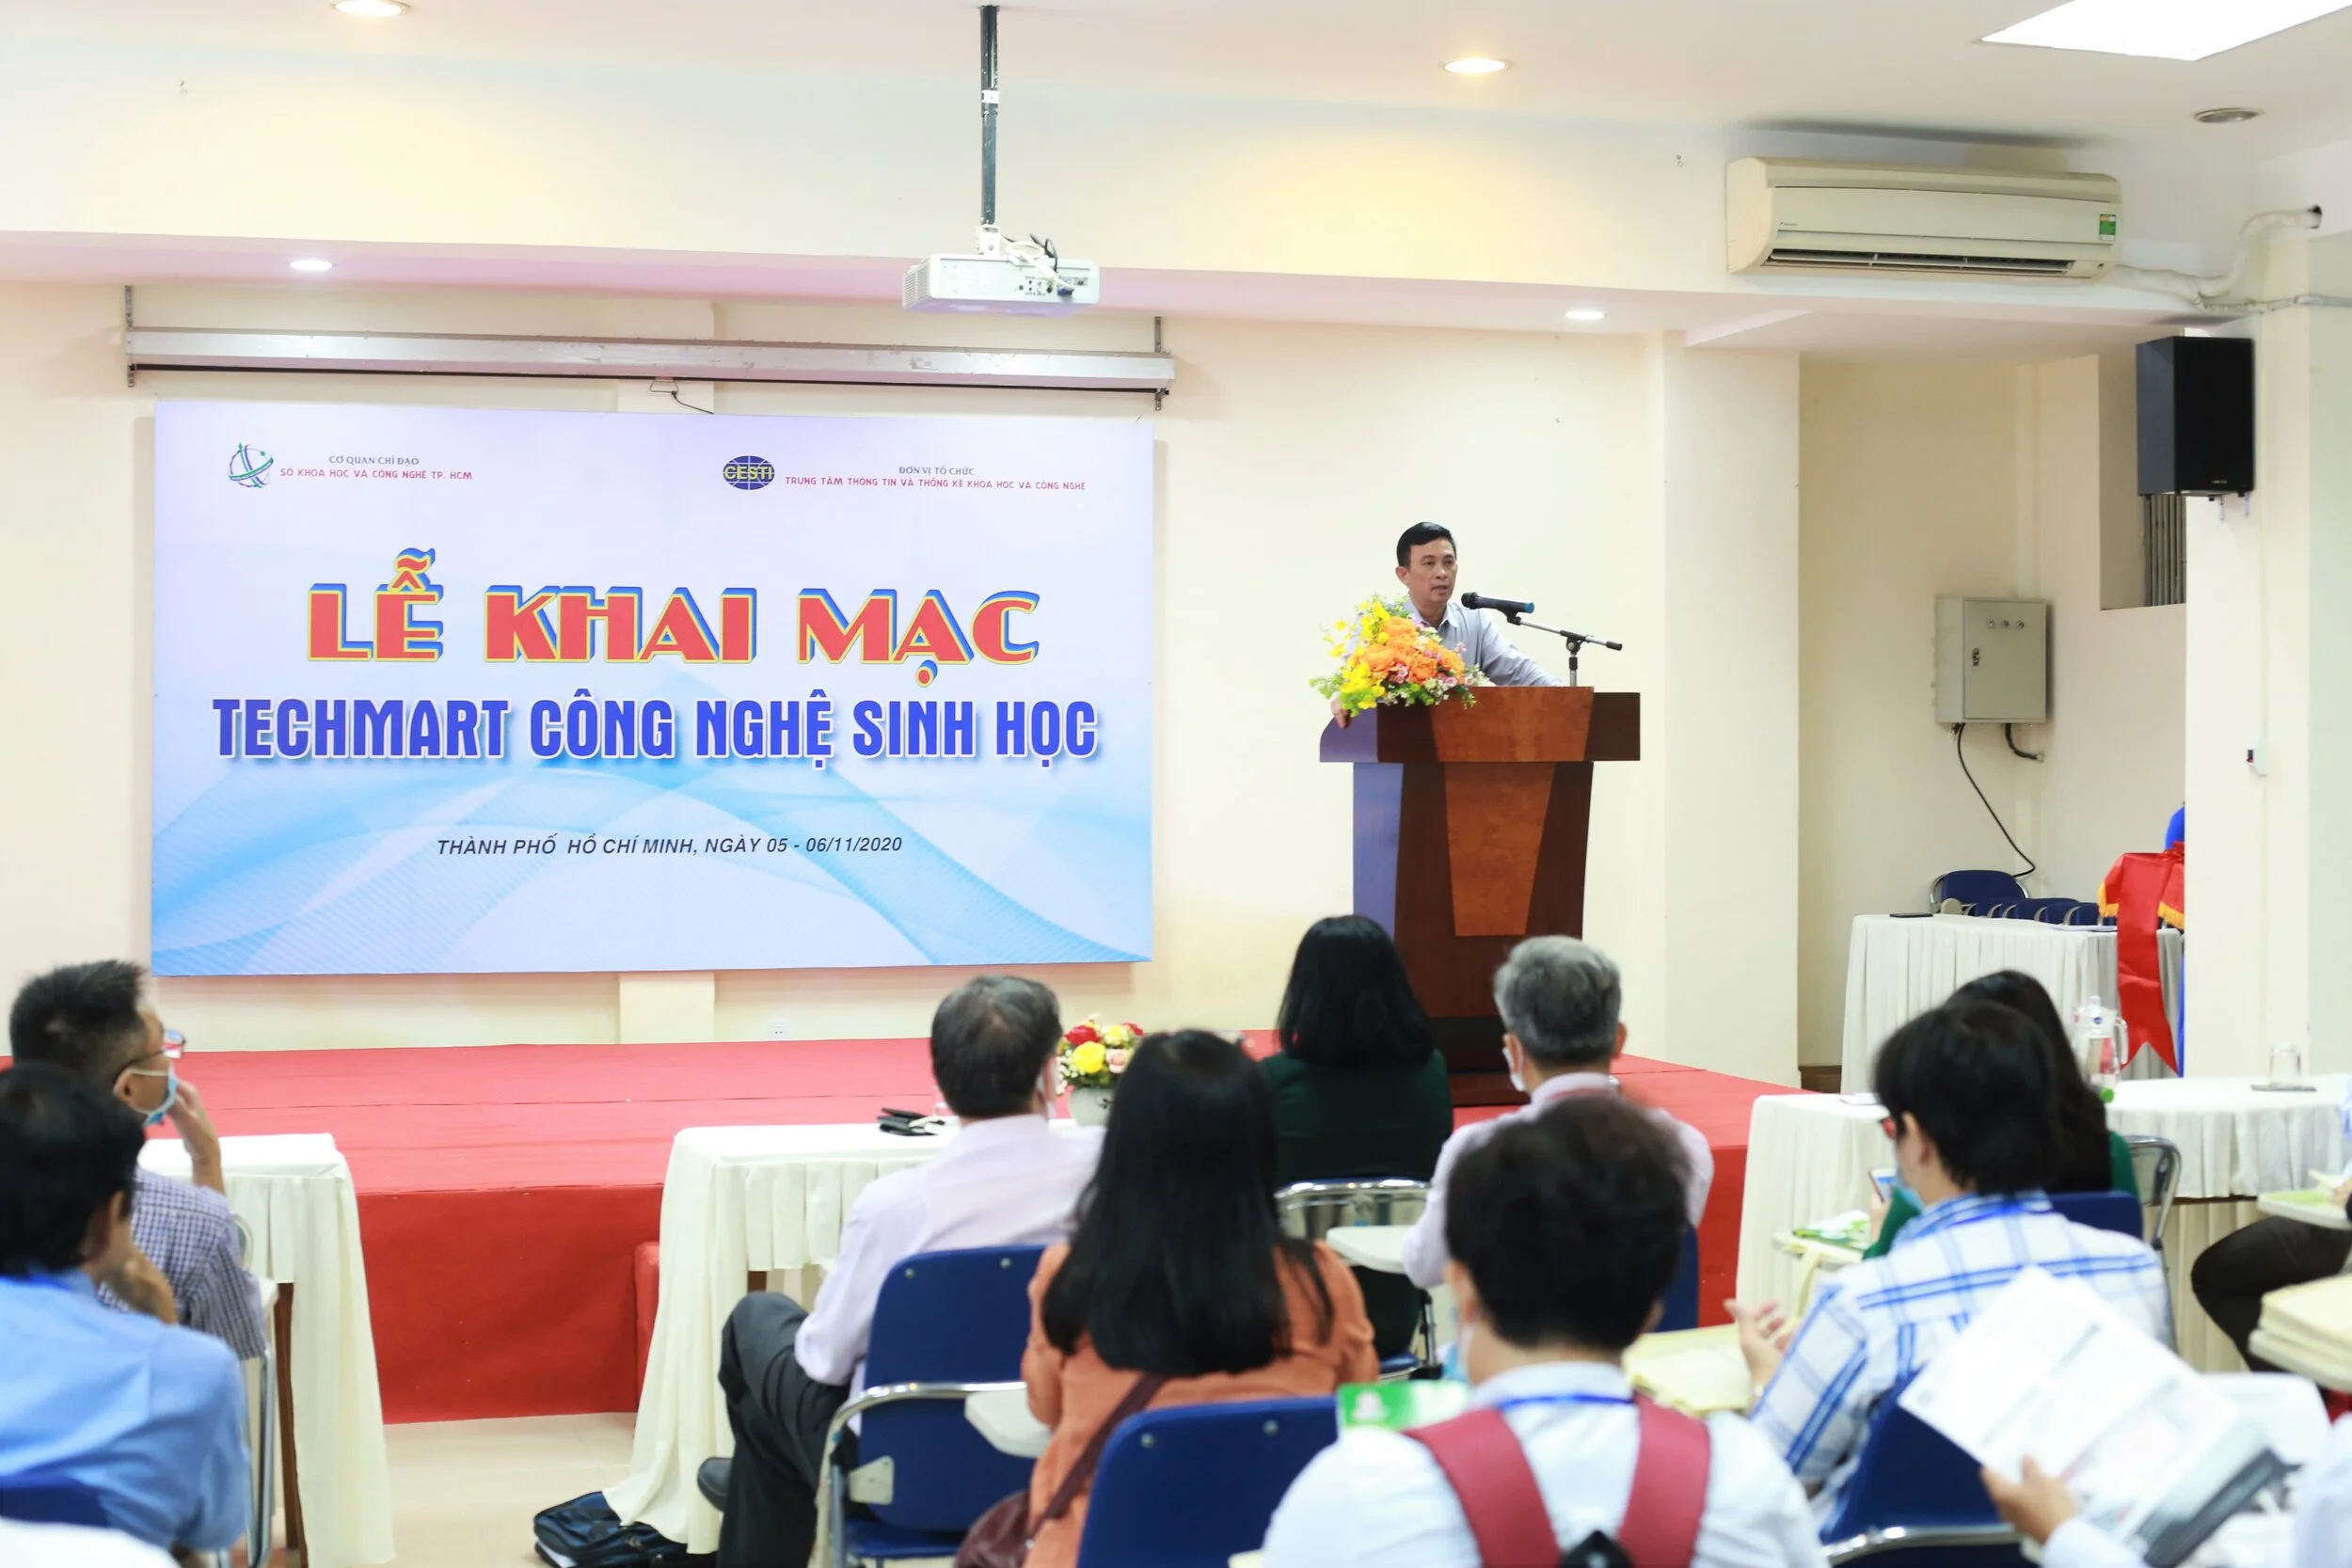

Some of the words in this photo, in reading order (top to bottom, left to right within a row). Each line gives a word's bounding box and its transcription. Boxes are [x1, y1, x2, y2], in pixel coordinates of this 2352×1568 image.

[328, 455, 344, 464] CƠ
[346, 456, 375, 465] QUAN
[297, 468, 326, 477] KHOA
[450, 471, 472, 480] HCM
[723, 466, 772, 480] CESTI
[898, 466, 920, 474] ĐƠN
[786, 476, 817, 485] TRUNG
[882, 478, 897, 486] TIN
[966, 480, 993, 488] KHOA
[308, 547, 443, 662] LỄ
[484, 585, 756, 664] KHAI
[796, 588, 1040, 688] MẠC
[213, 698, 510, 757] TECHMART
[530, 689, 673, 757] CÔNG
[696, 689, 832, 768] NGHỆ
[852, 700, 975, 757] SINH
[996, 701, 1095, 767] HỌC
[437, 835, 507, 855] THÀNH
[513, 832, 558, 855] PHỐ
[567, 832, 596, 854] HỒ
[603, 834, 640, 854] CHÍ
[643, 838, 697, 855] MINH,
[705, 834, 761, 853] NGÀY
[767, 837, 788, 853] 05
[805, 836, 903, 852] 06/11/2020
